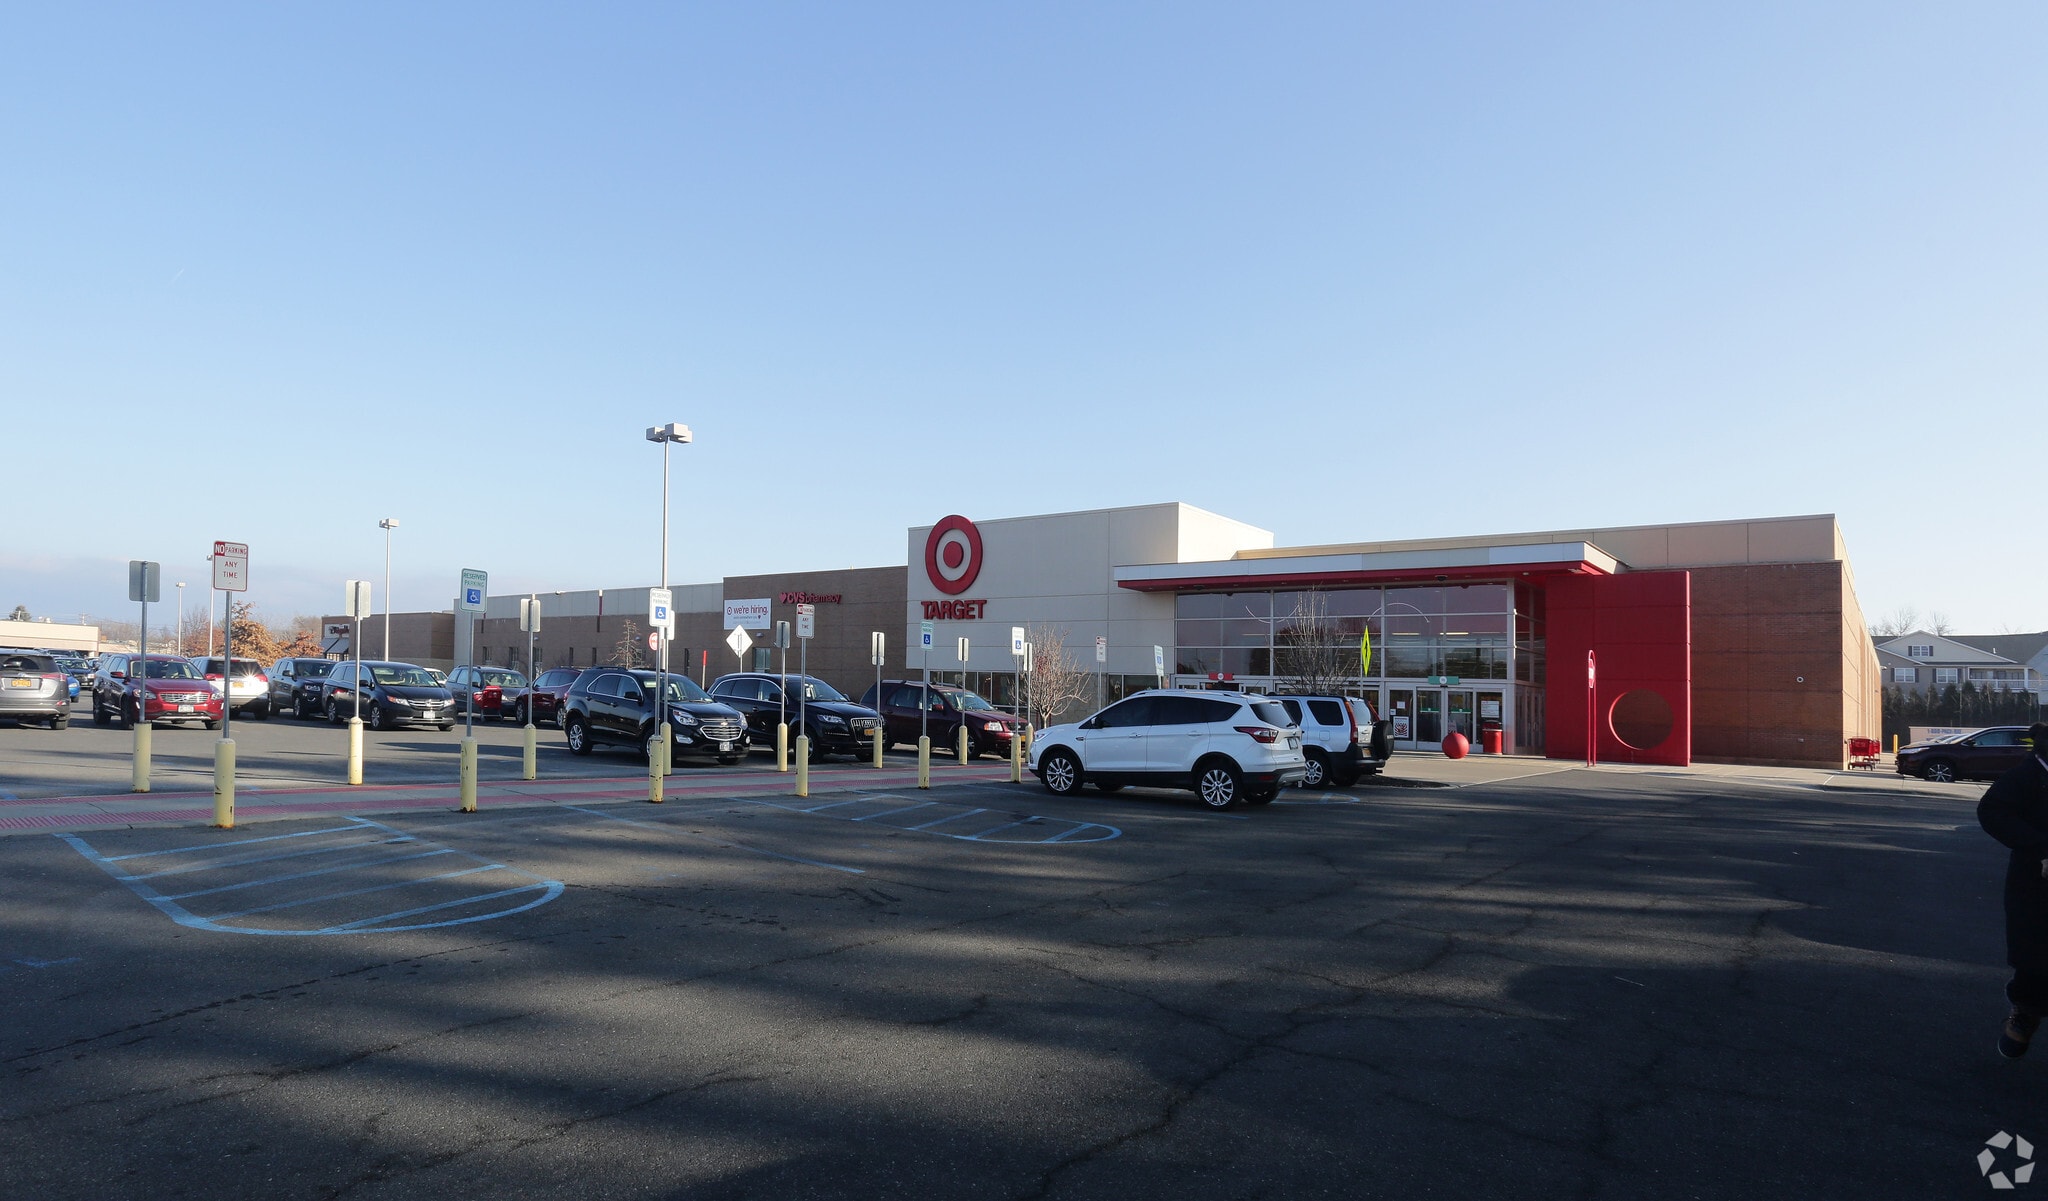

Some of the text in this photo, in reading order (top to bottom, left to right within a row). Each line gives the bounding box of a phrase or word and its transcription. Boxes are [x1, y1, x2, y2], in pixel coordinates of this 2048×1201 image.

[215, 544, 247, 555] NO PARKING
[223, 571, 238, 579] TIME
[787, 592, 842, 604] CVS pharmacy
[733, 605, 749, 615] we're
[921, 600, 988, 620] TARGET
